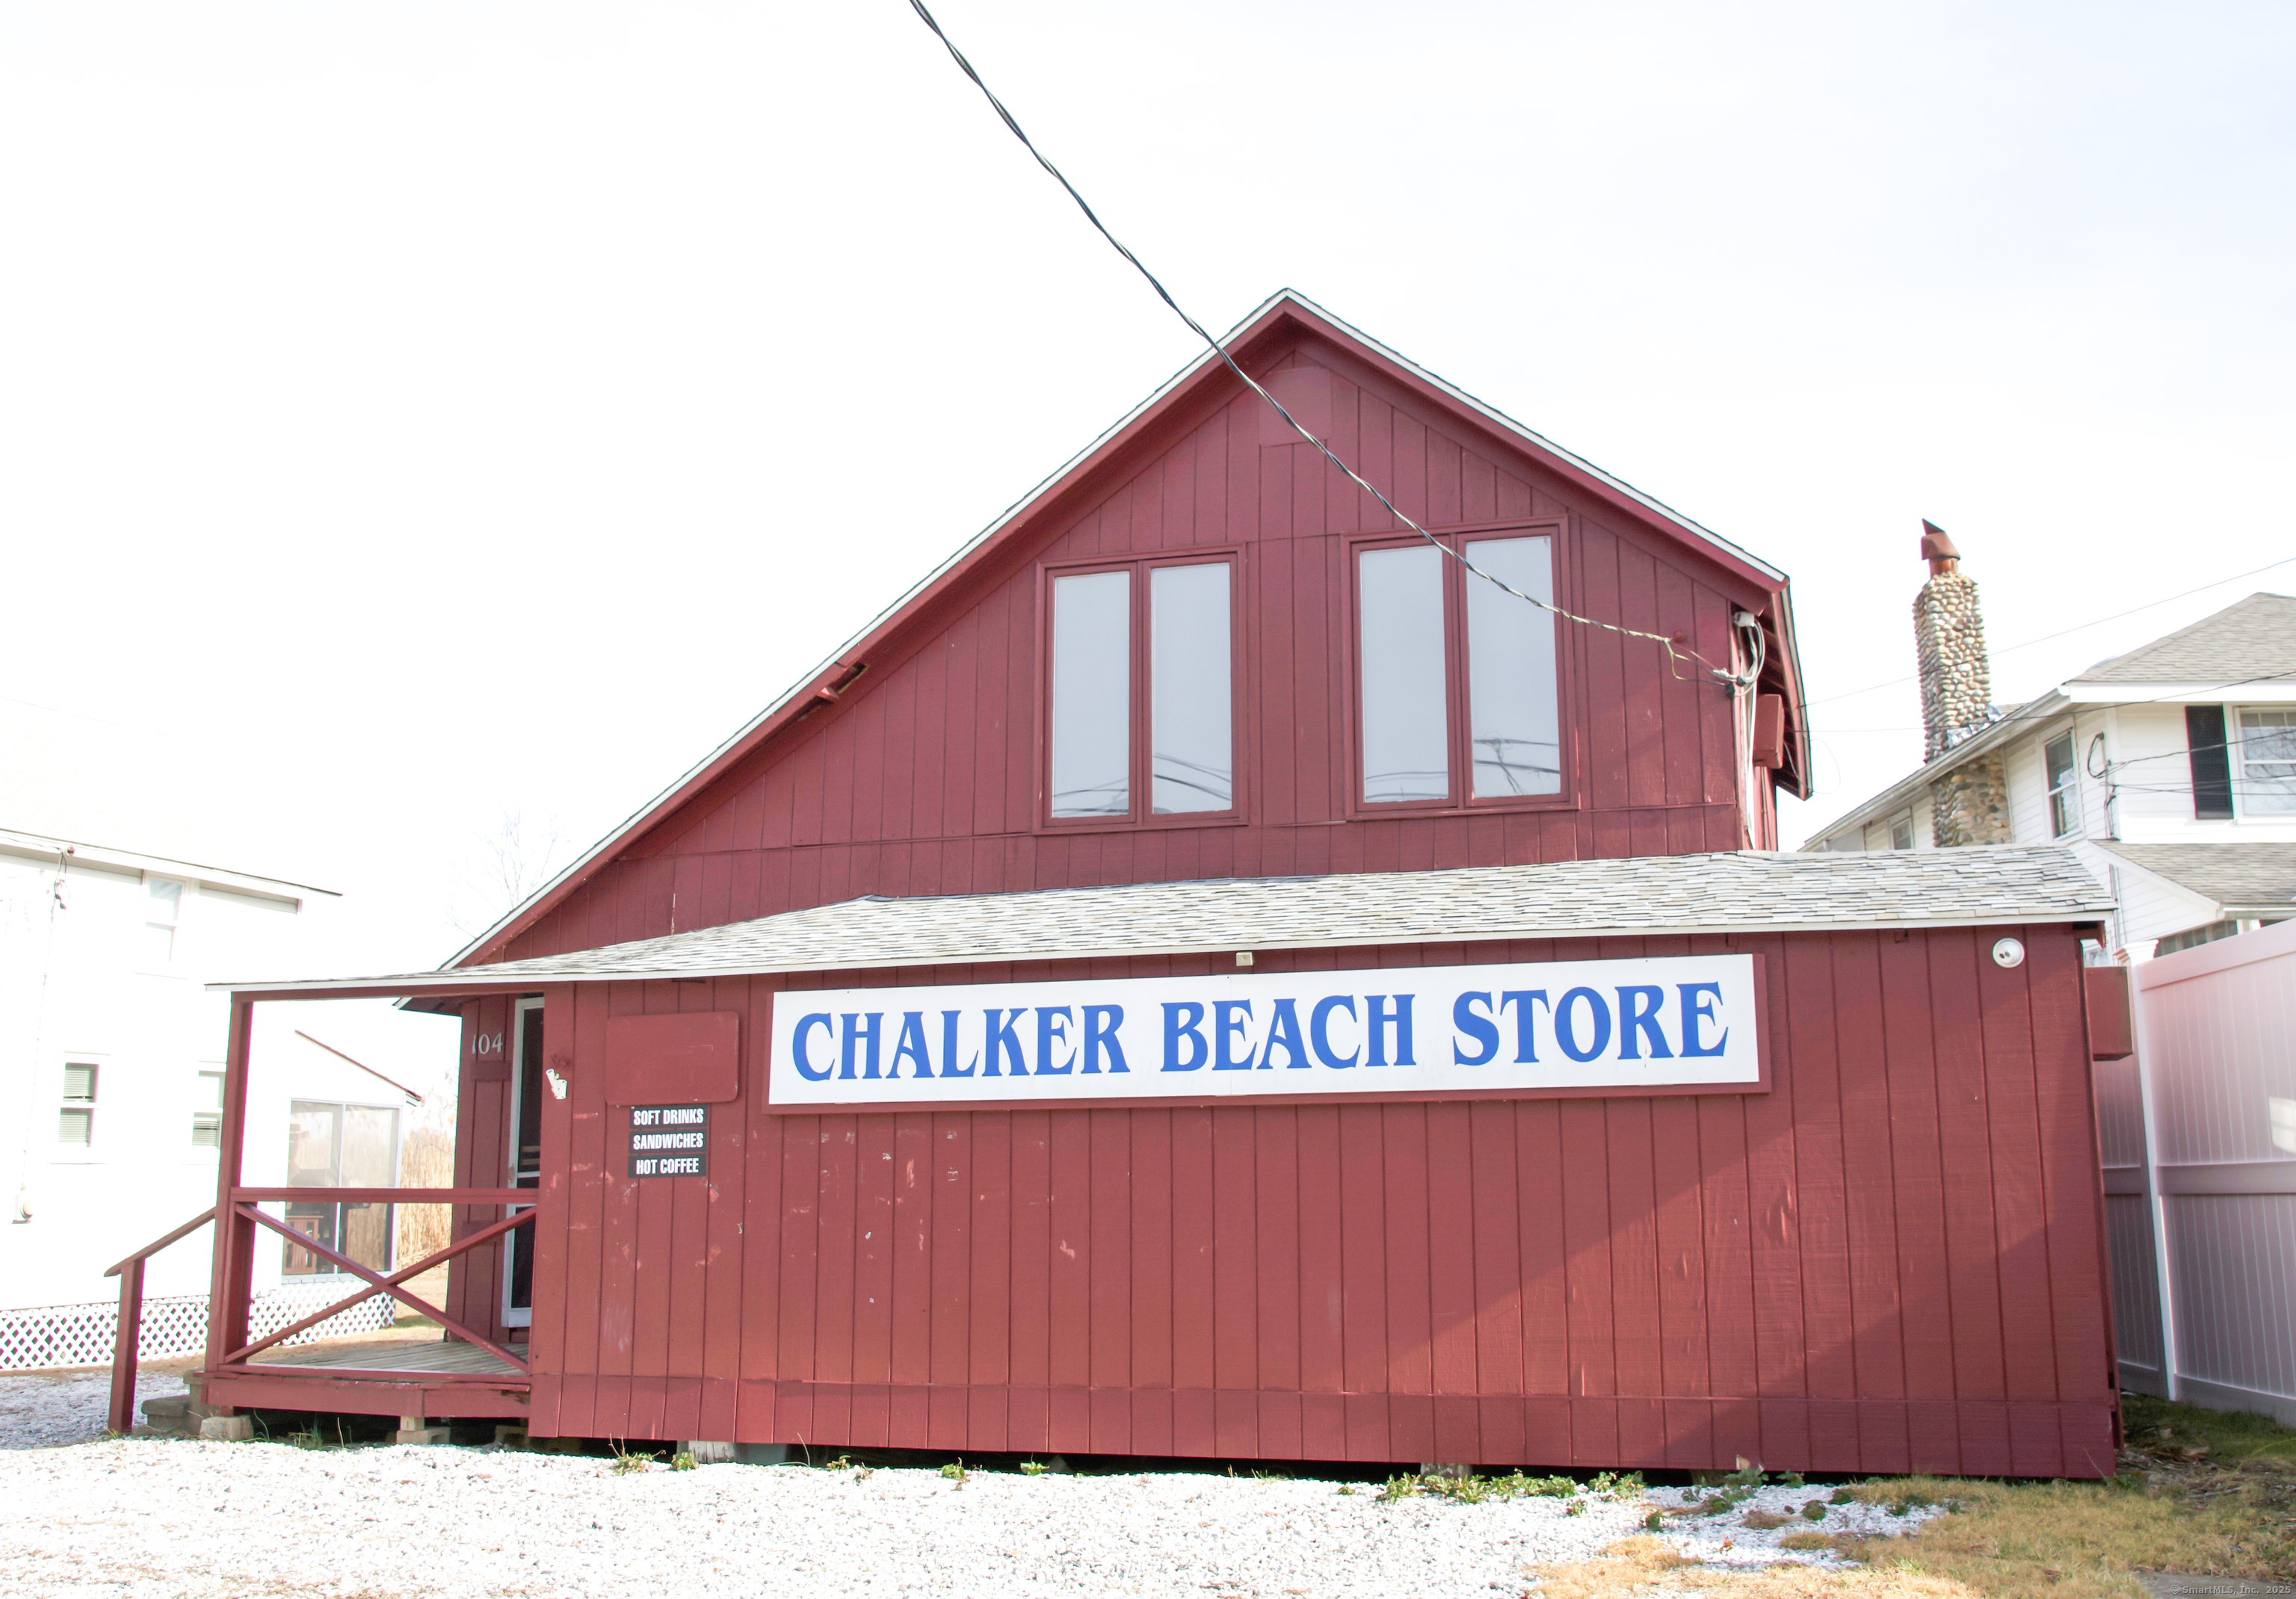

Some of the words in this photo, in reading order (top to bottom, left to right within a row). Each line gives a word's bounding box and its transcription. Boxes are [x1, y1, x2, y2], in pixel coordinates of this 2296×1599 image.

[792, 1004, 1130, 1082] CHALKER
[1160, 994, 1416, 1073] BEACH
[1452, 981, 1729, 1066] STORE
[472, 1032, 503, 1054] 104
[633, 1110, 660, 1126] SOFT
[663, 1108, 704, 1125] DRINKS
[633, 1132, 703, 1150] SANDWICHES
[635, 1159, 658, 1175] HOT
[660, 1157, 699, 1174] COFFEE
